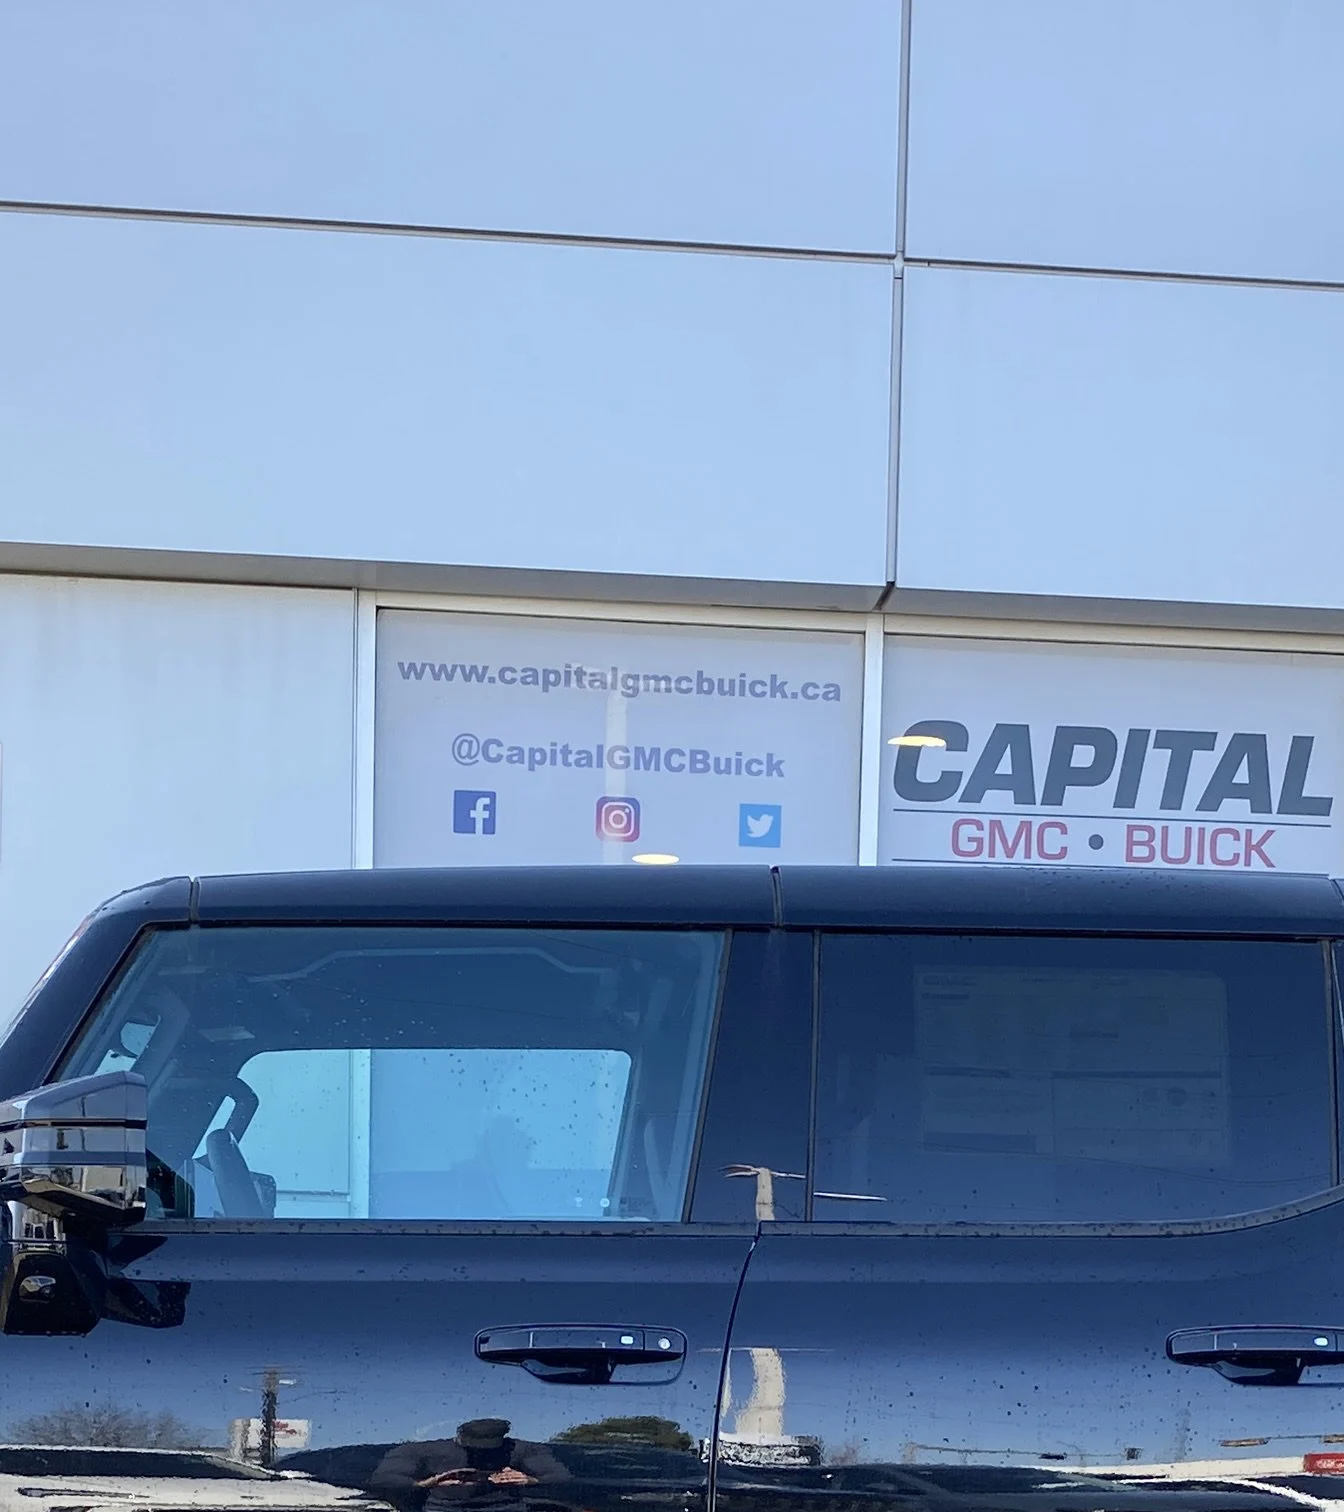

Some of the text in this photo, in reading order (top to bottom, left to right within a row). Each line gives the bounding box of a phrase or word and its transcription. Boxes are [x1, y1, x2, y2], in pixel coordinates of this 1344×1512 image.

[397, 658, 841, 702] www.capitalgmcbuick.ca
[451, 732, 786, 779] @CapitalGMCBuick
[892, 719, 1334, 817] CAPITAL
[950, 818, 1277, 869] GMC BUICK
